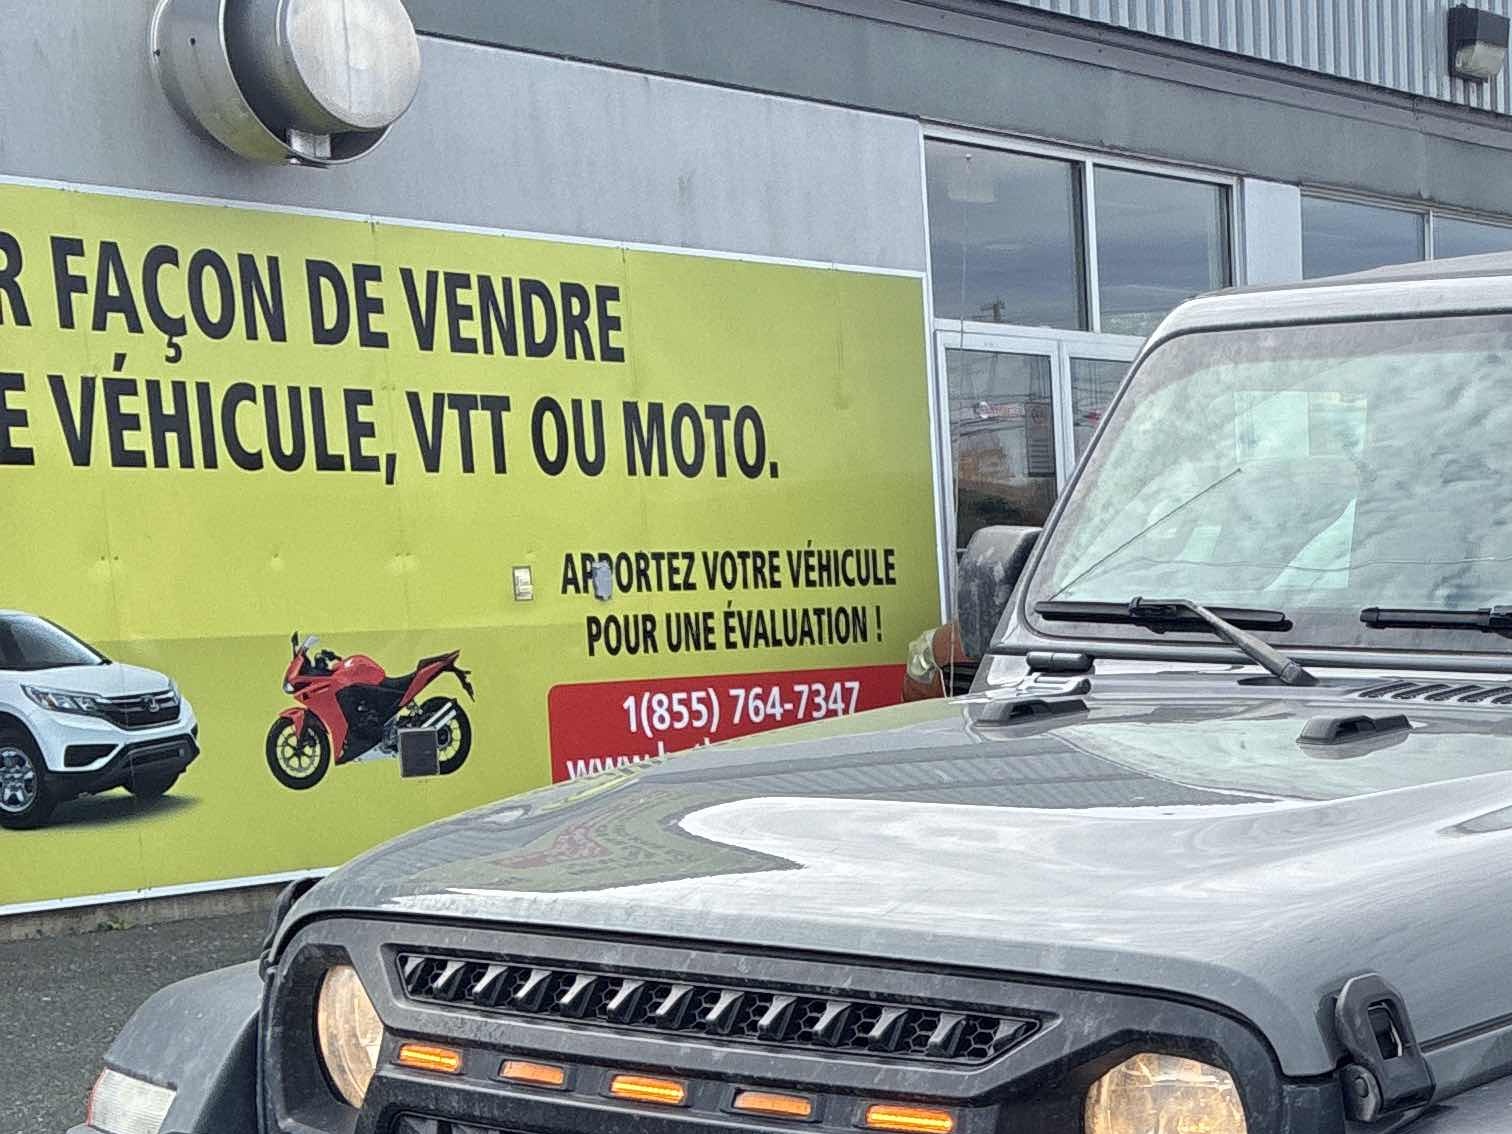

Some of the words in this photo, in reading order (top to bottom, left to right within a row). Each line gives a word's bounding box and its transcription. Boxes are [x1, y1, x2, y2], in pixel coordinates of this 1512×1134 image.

[50, 235, 288, 364] FAÇON
[304, 258, 390, 348] DE
[399, 267, 626, 362] VENDRE
[46, 352, 397, 485] VÉHICULE,
[405, 391, 511, 474] VTT
[531, 396, 606, 477] OU
[622, 401, 779, 479] MOTO.
[702, 549, 782, 591] VOTRE
[786, 540, 897, 588] VÉHICULE
[586, 612, 659, 656] POUR
[666, 611, 715, 652] UNE
[724, 600, 869, 649] ÉVALUATION
[623, 687, 720, 738] 1(855)
[728, 681, 860, 725] 764-7347
